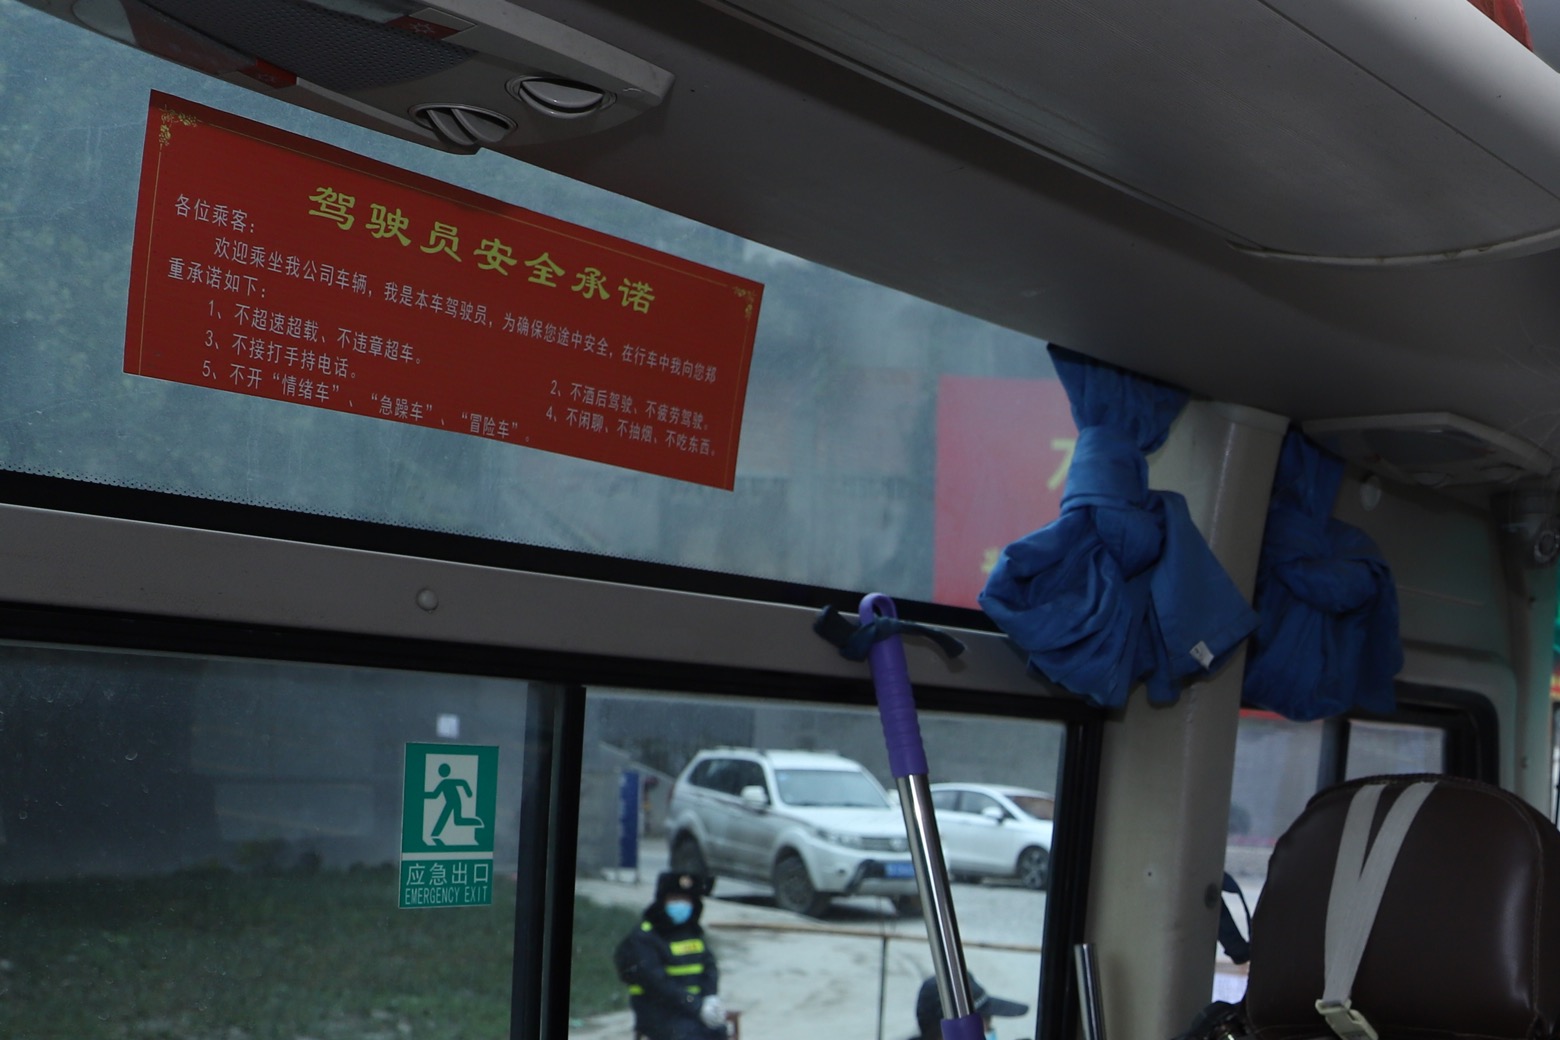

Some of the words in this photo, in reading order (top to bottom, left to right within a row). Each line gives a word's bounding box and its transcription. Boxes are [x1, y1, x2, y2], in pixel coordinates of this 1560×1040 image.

[174, 193, 255, 233] 各位乘客：
[308, 186, 656, 315] 驾驶员安全承诺
[167, 256, 266, 298] 重承诺如下：
[406, 861, 489, 886] 应急出口
[405, 886, 460, 905] EMERGENCY
[464, 885, 488, 903] EXIT
